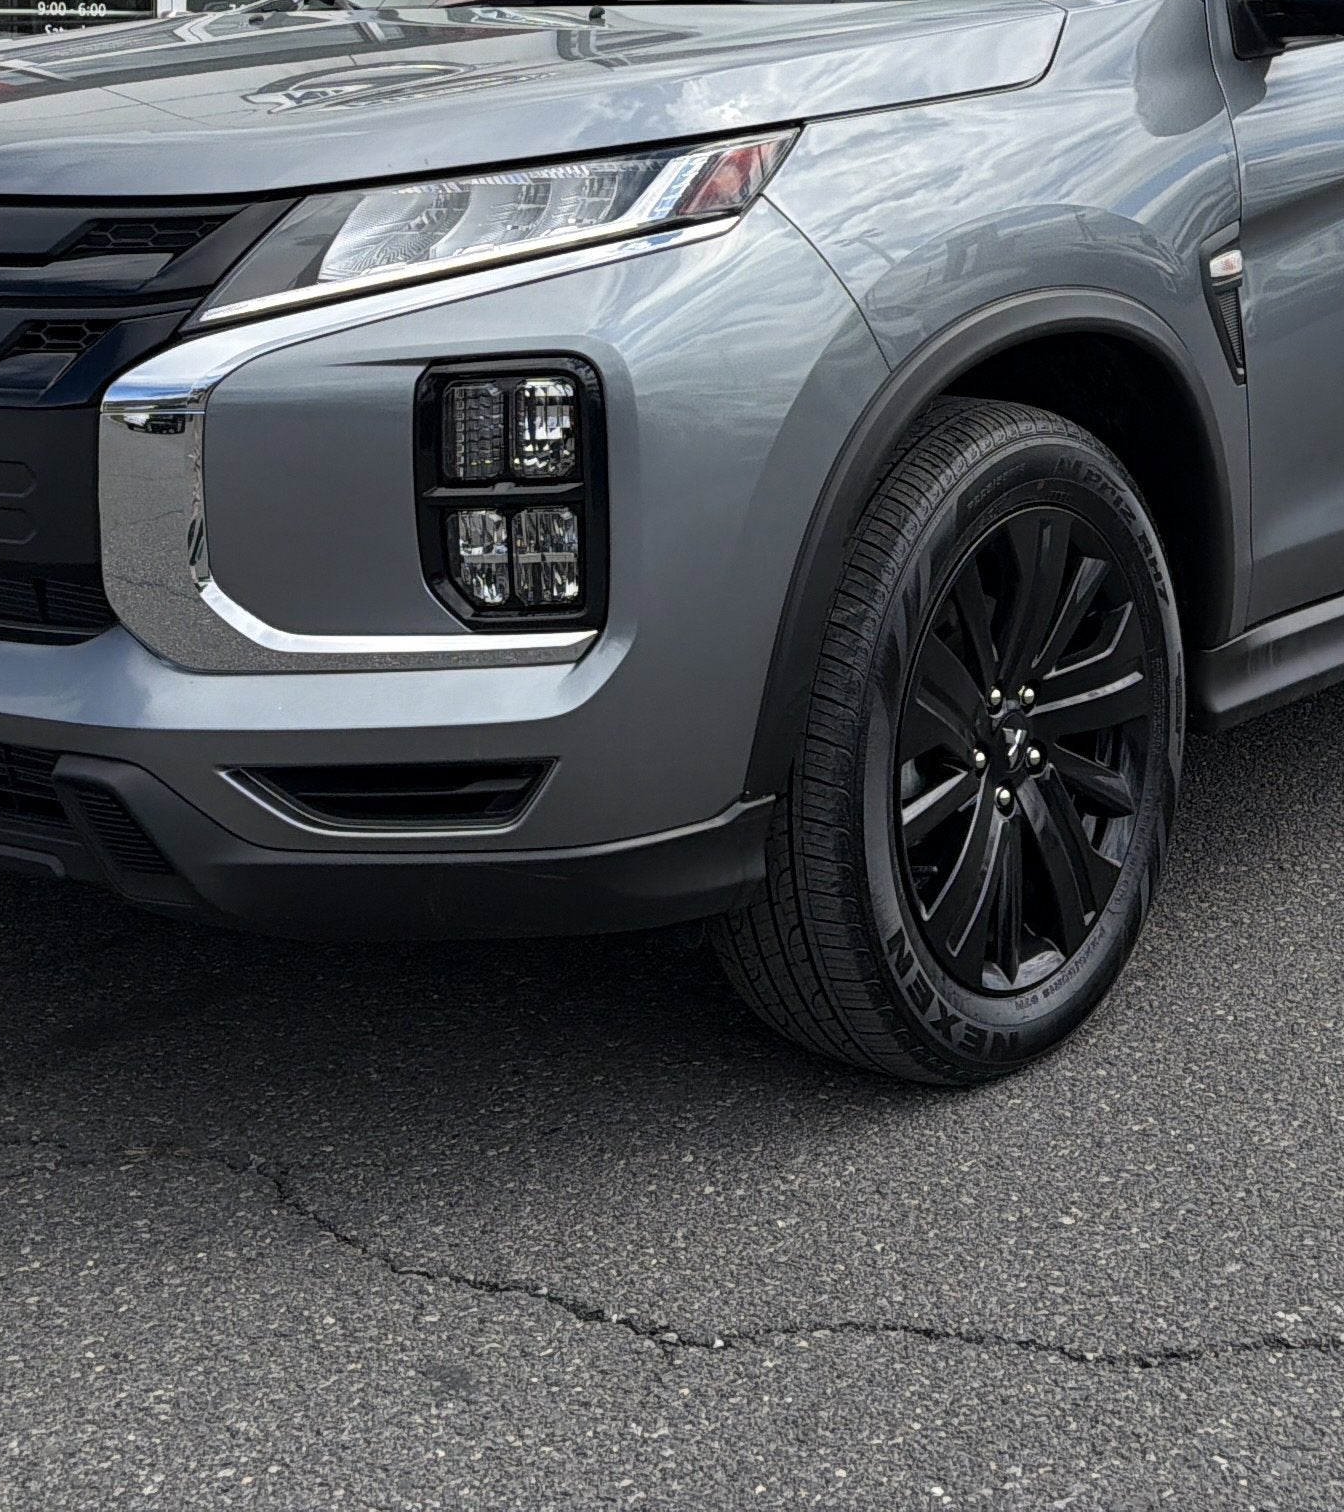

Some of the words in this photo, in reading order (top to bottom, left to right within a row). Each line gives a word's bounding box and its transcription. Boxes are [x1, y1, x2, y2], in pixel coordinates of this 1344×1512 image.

[37, 1, 66, 16] 9:00
[78, 3, 106, 17] 6:00
[886, 926, 1020, 1056] NEXEN
